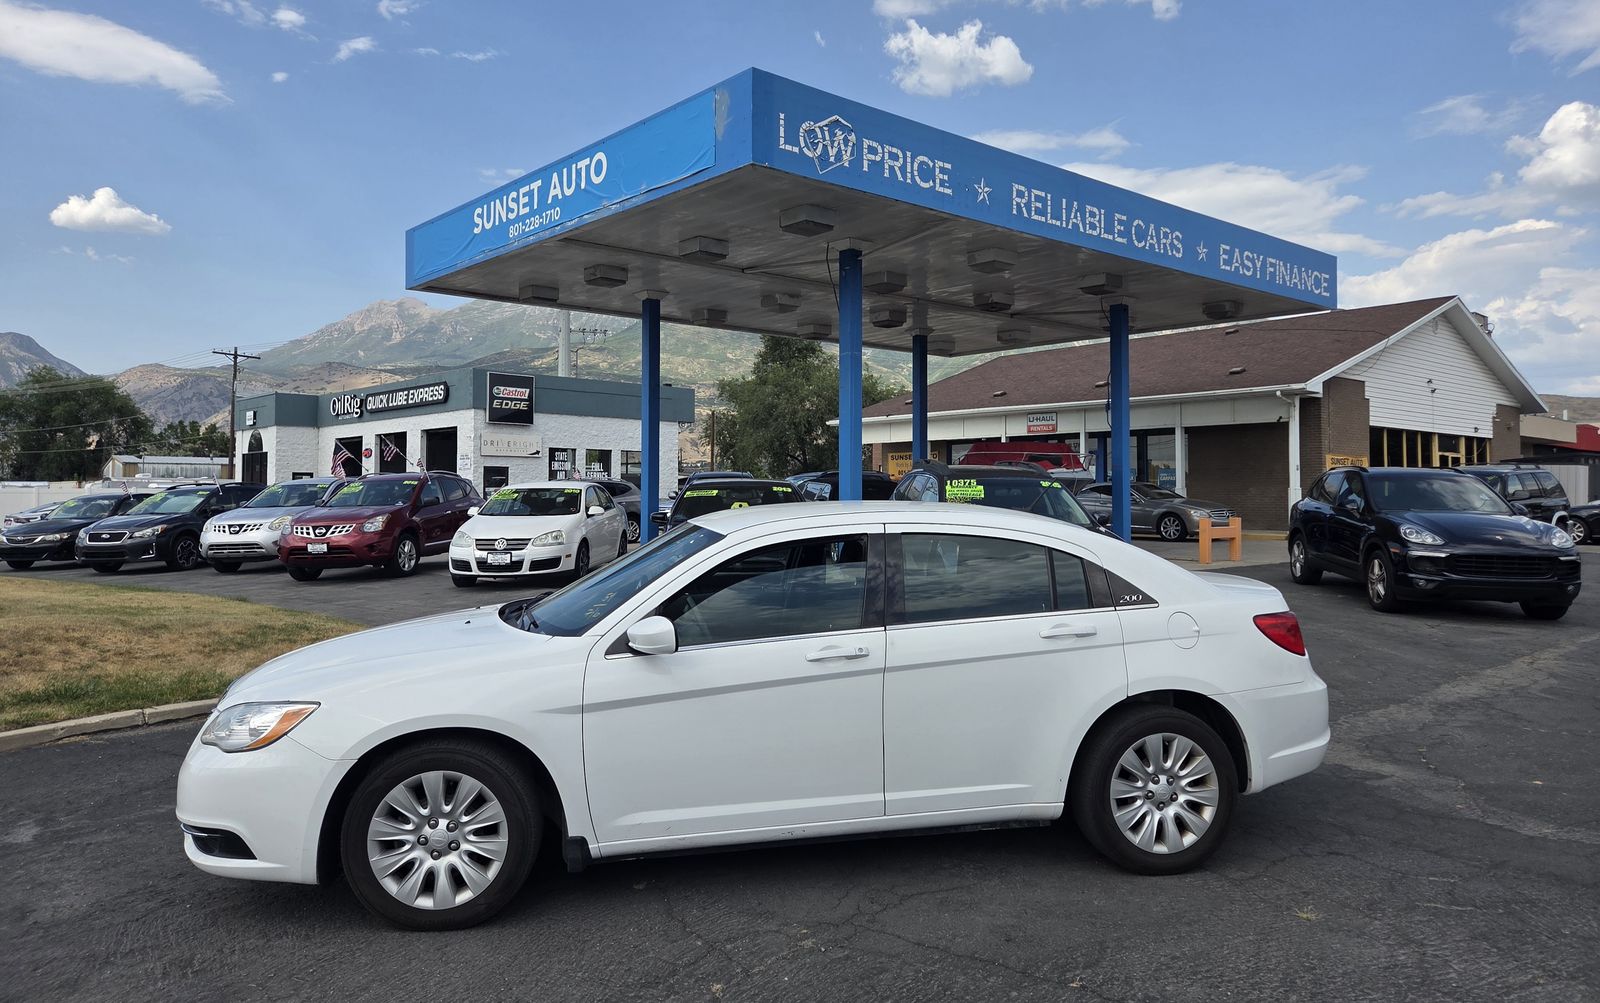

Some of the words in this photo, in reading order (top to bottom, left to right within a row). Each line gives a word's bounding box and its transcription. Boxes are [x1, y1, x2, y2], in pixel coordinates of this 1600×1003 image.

[473, 179, 541, 234] SUNSET
[547, 152, 608, 204] AUTO
[779, 113, 855, 168] LOW
[862, 138, 953, 195] PRICE
[1012, 183, 1128, 244] RELIABLE
[1131, 219, 1183, 258] CARS
[1219, 244, 1264, 279] EASY
[1266, 257, 1330, 297] FINANCE
[509, 207, 561, 238] 801-228-1710
[366, 394, 389, 410] QUICK
[388, 391, 408, 407] LUBE
[408, 385, 444, 404] EXPRESS
[502, 388, 528, 398] Castrol
[330, 393, 361, 417] OilRig
[492, 400, 529, 410] EDGE
[483, 440, 541, 449] DRIVERIGHT
[554, 452, 567, 461] STATE
[591, 462, 603, 471] FULL
[1330, 457, 1350, 466] SUNSET
[1350, 459, 1364, 467] AUTO
[946, 479, 977, 487] 10375
[1120, 594, 1142, 603] 200
